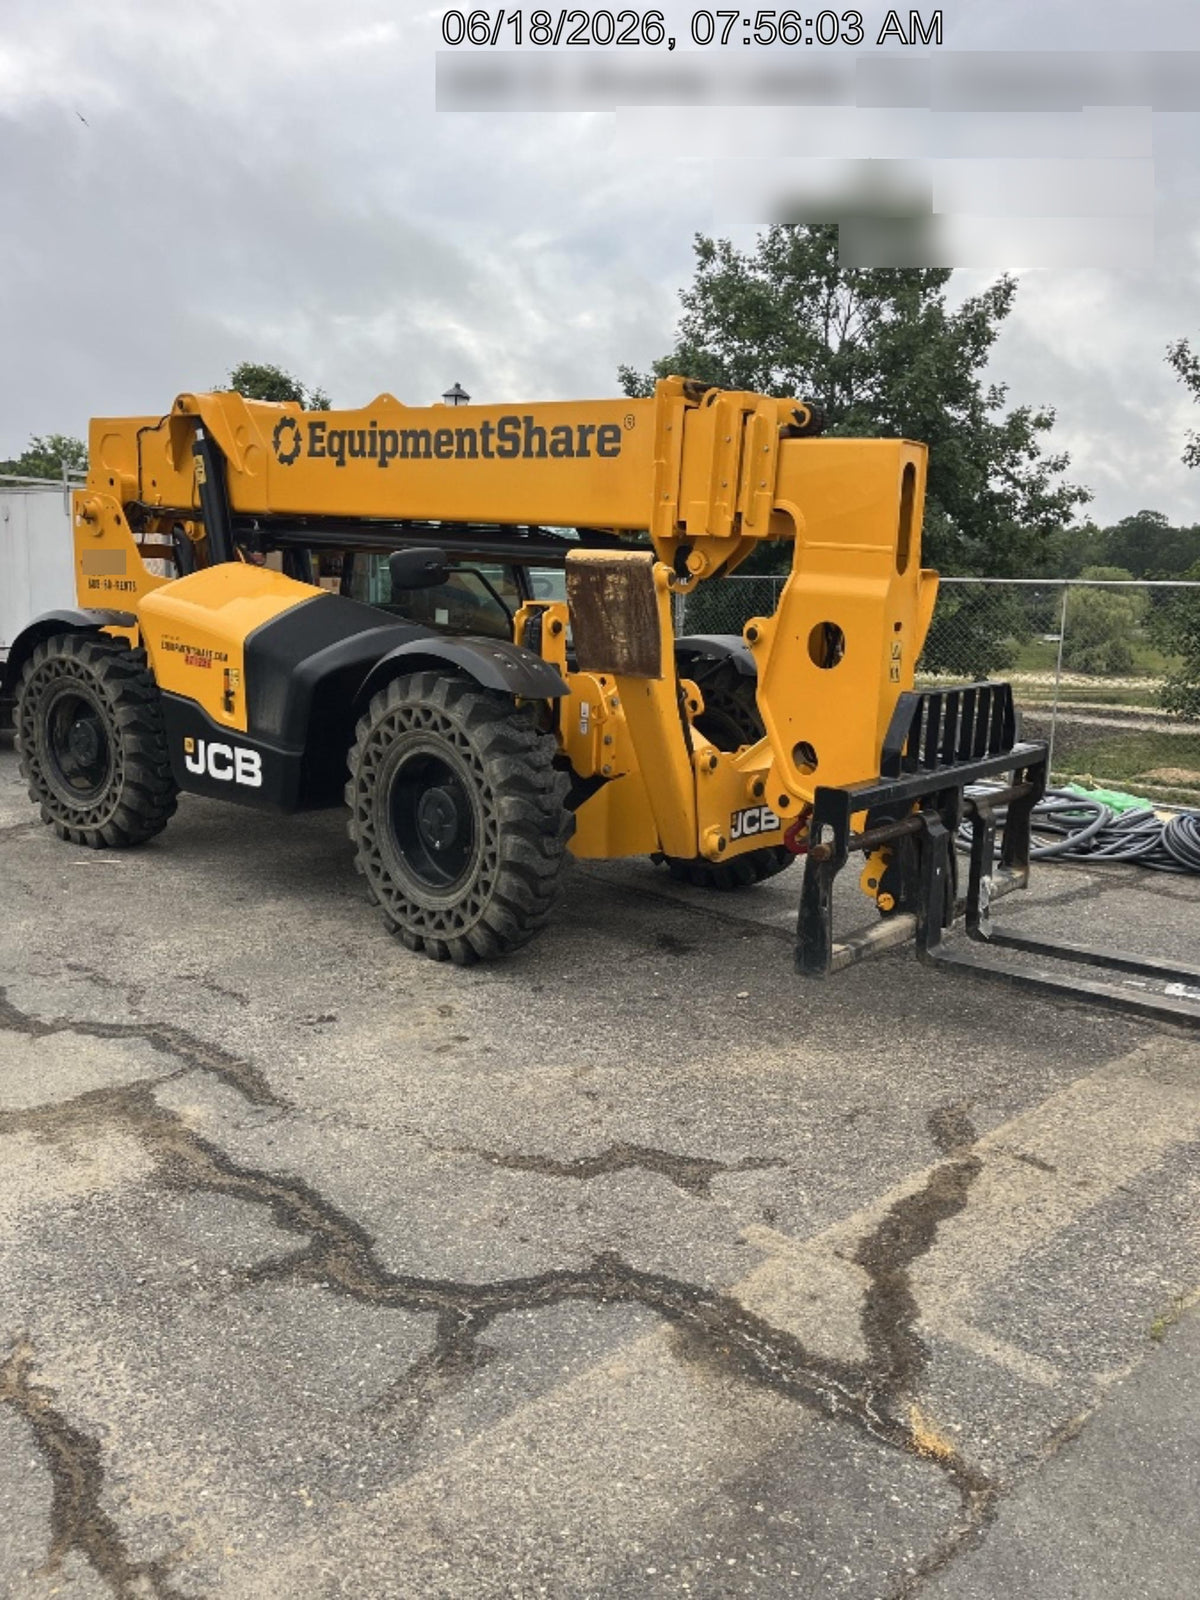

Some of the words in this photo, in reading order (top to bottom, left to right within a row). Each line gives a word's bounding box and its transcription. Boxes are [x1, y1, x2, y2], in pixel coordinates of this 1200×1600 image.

[307, 415, 622, 468] EquipmentShare
[184, 737, 263, 788] JCB
[731, 806, 780, 839] JCB
